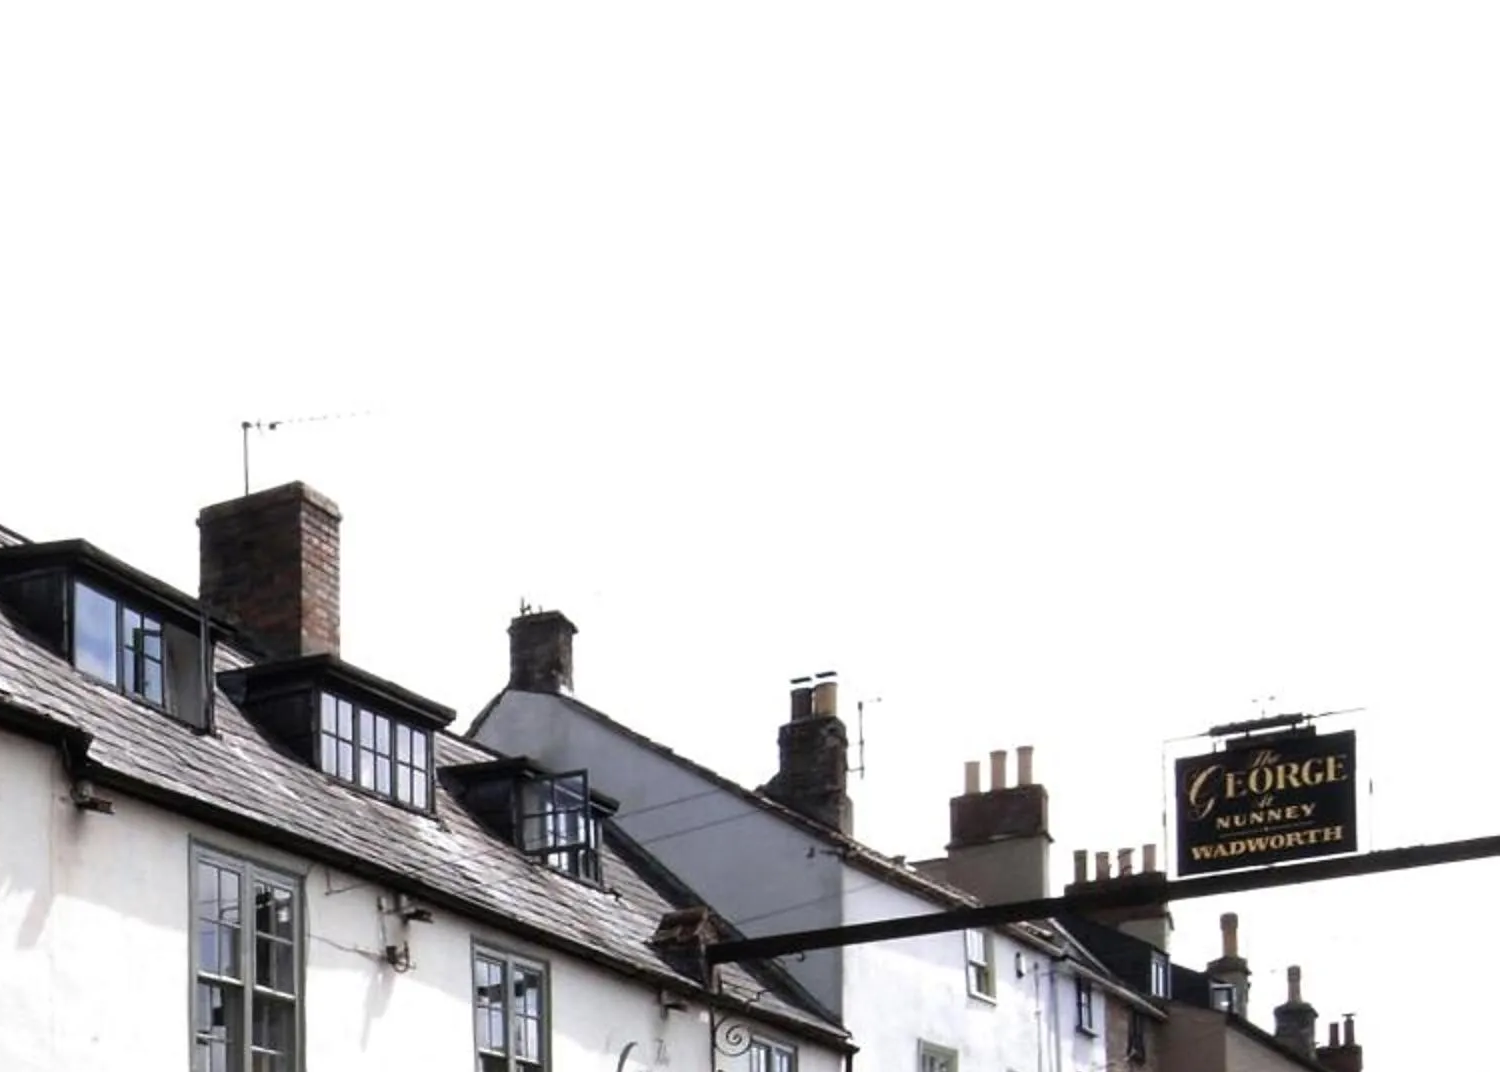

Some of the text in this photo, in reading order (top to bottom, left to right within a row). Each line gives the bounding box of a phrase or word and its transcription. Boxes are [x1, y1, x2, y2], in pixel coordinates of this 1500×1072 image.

[1186, 756, 1348, 820] GEORGE
[1215, 803, 1316, 829] NUNNEY
[1191, 825, 1344, 860] WADWORTH
